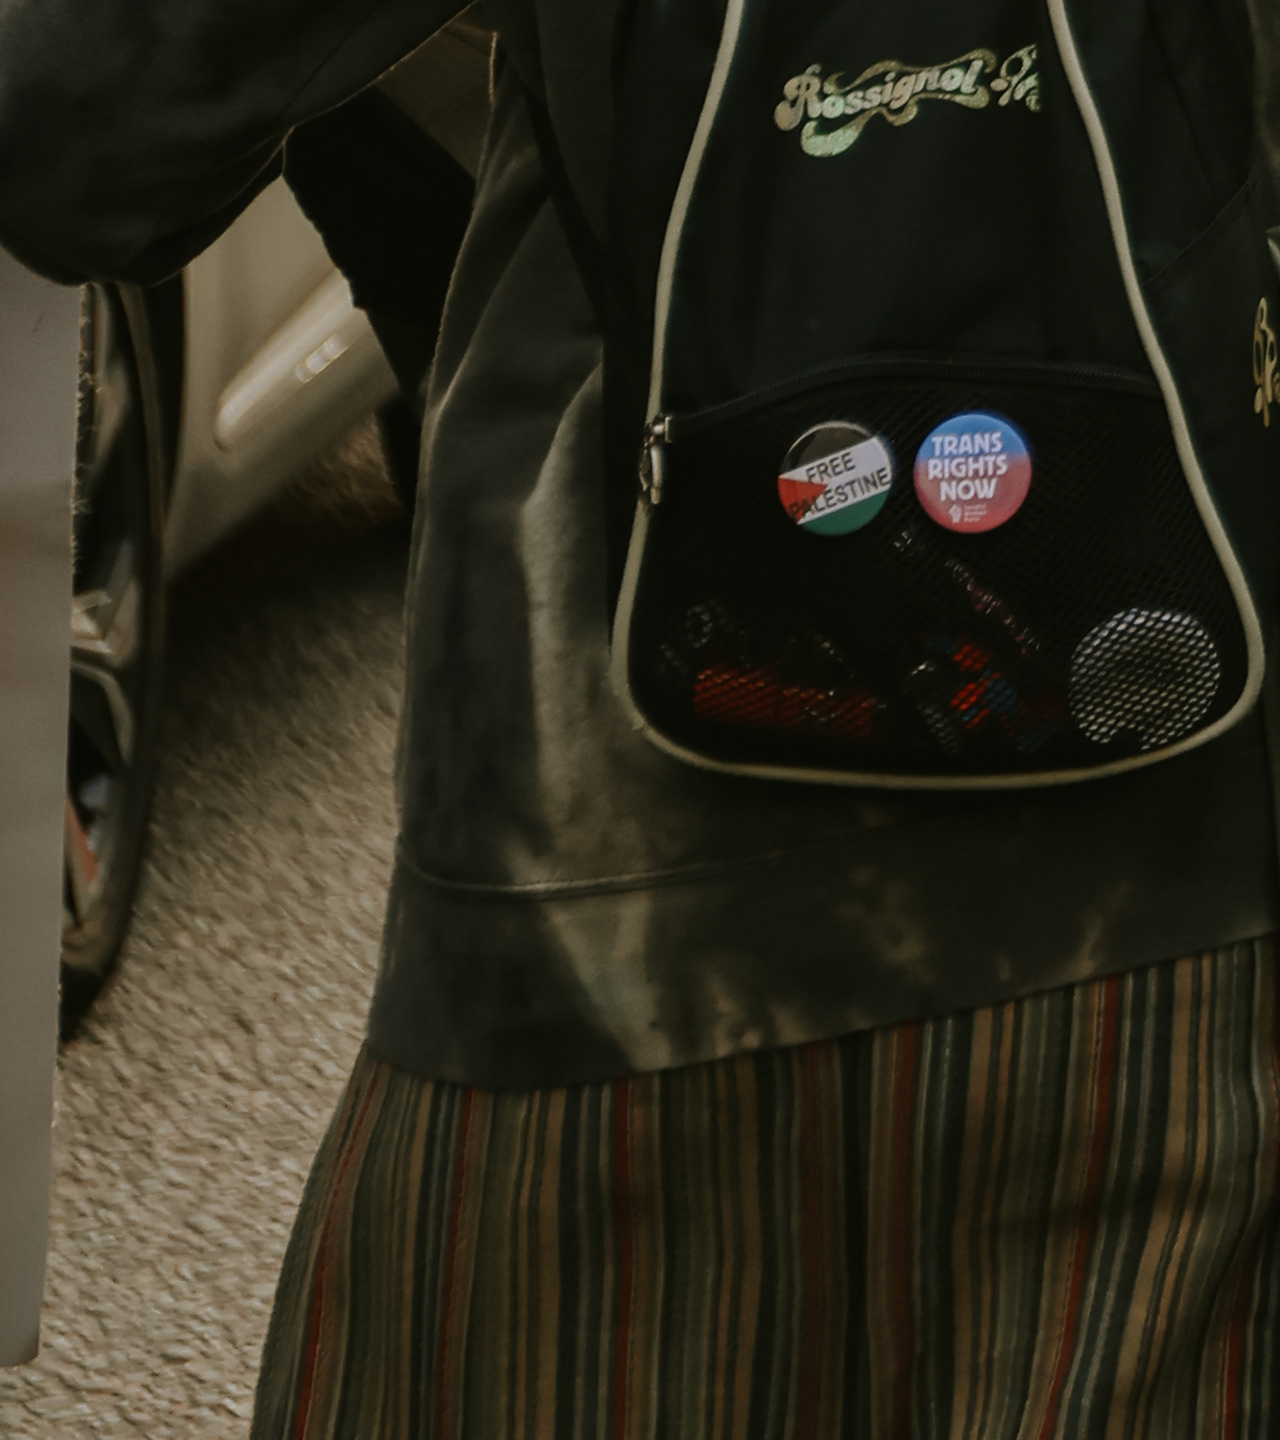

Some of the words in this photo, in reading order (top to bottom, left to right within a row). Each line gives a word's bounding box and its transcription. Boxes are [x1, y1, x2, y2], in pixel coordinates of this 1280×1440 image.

[774, 59, 985, 131] Rossignol
[930, 431, 1003, 458] TRANS
[805, 450, 857, 484] FREE
[927, 454, 1009, 481] RIGHTS
[789, 466, 892, 518] PALESTINE
[938, 477, 998, 503] NOW
